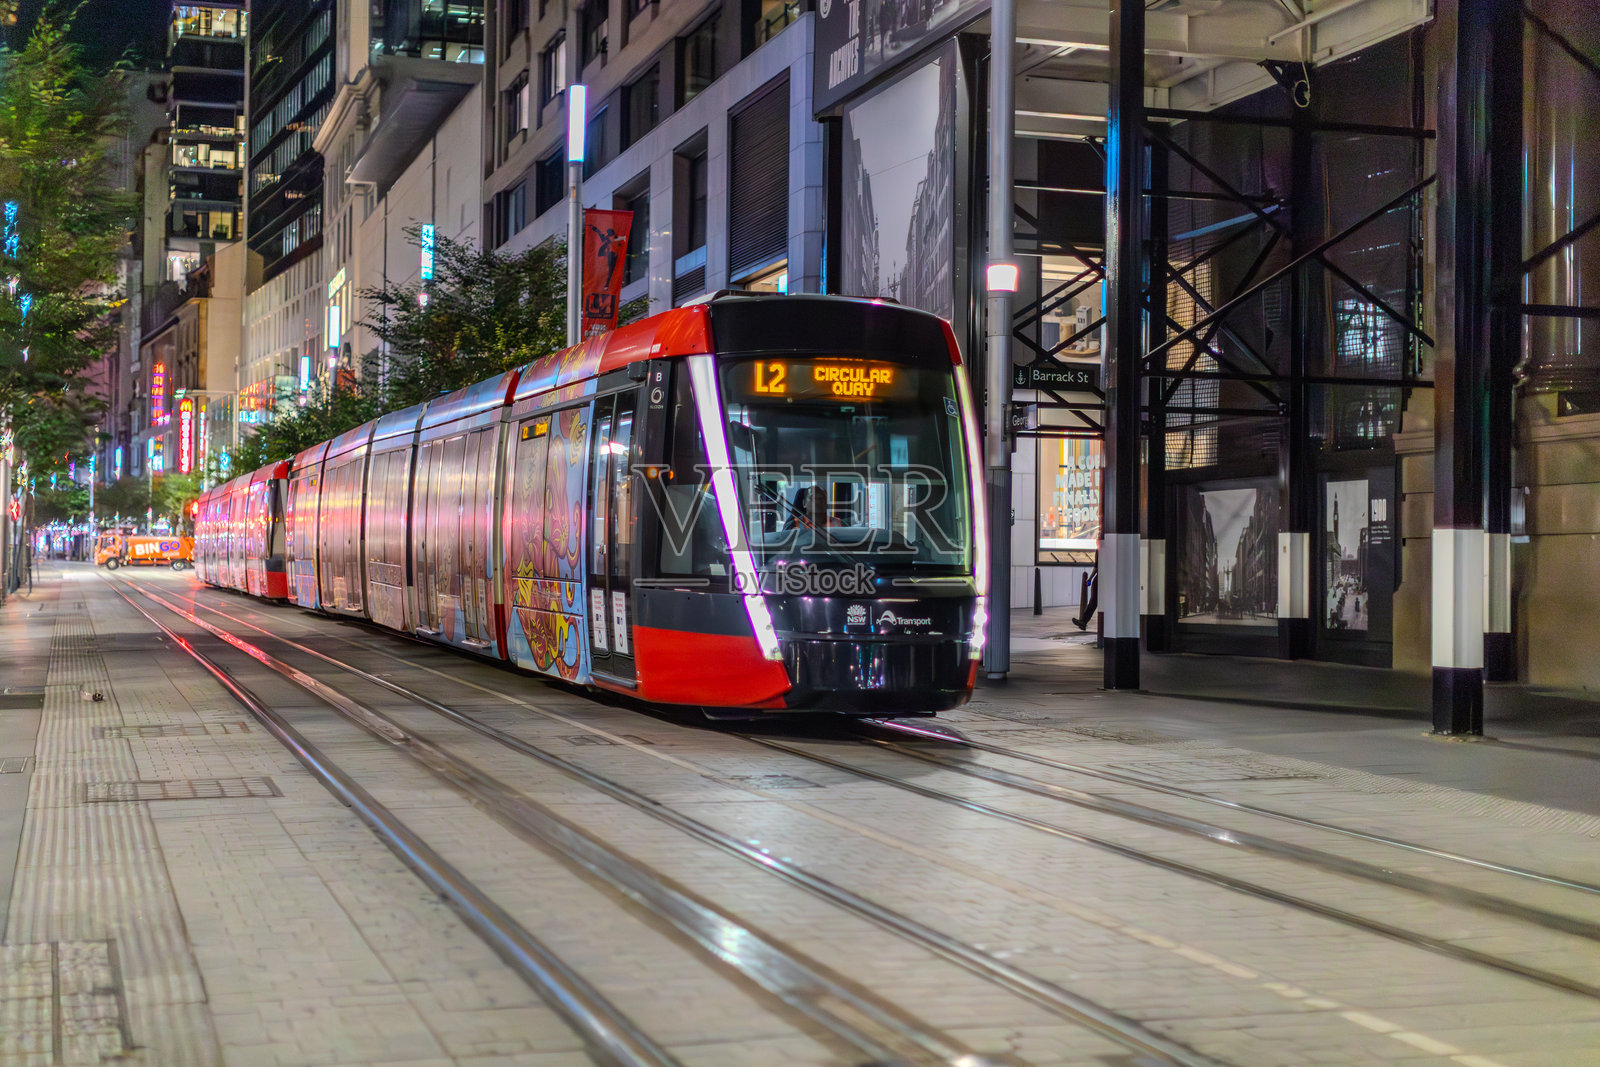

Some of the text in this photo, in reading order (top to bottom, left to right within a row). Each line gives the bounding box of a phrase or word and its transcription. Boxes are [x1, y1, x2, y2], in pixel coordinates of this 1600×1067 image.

[656, 372, 662, 382] B
[754, 361, 785, 393] L2
[814, 367, 891, 383] CIRCULAR
[1033, 369, 1089, 383] Barrack St
[832, 382, 874, 396] QUAY
[1055, 472, 1092, 488] MADE
[134, 541, 180, 556] BINGO
[896, 617, 931, 626] Transport
